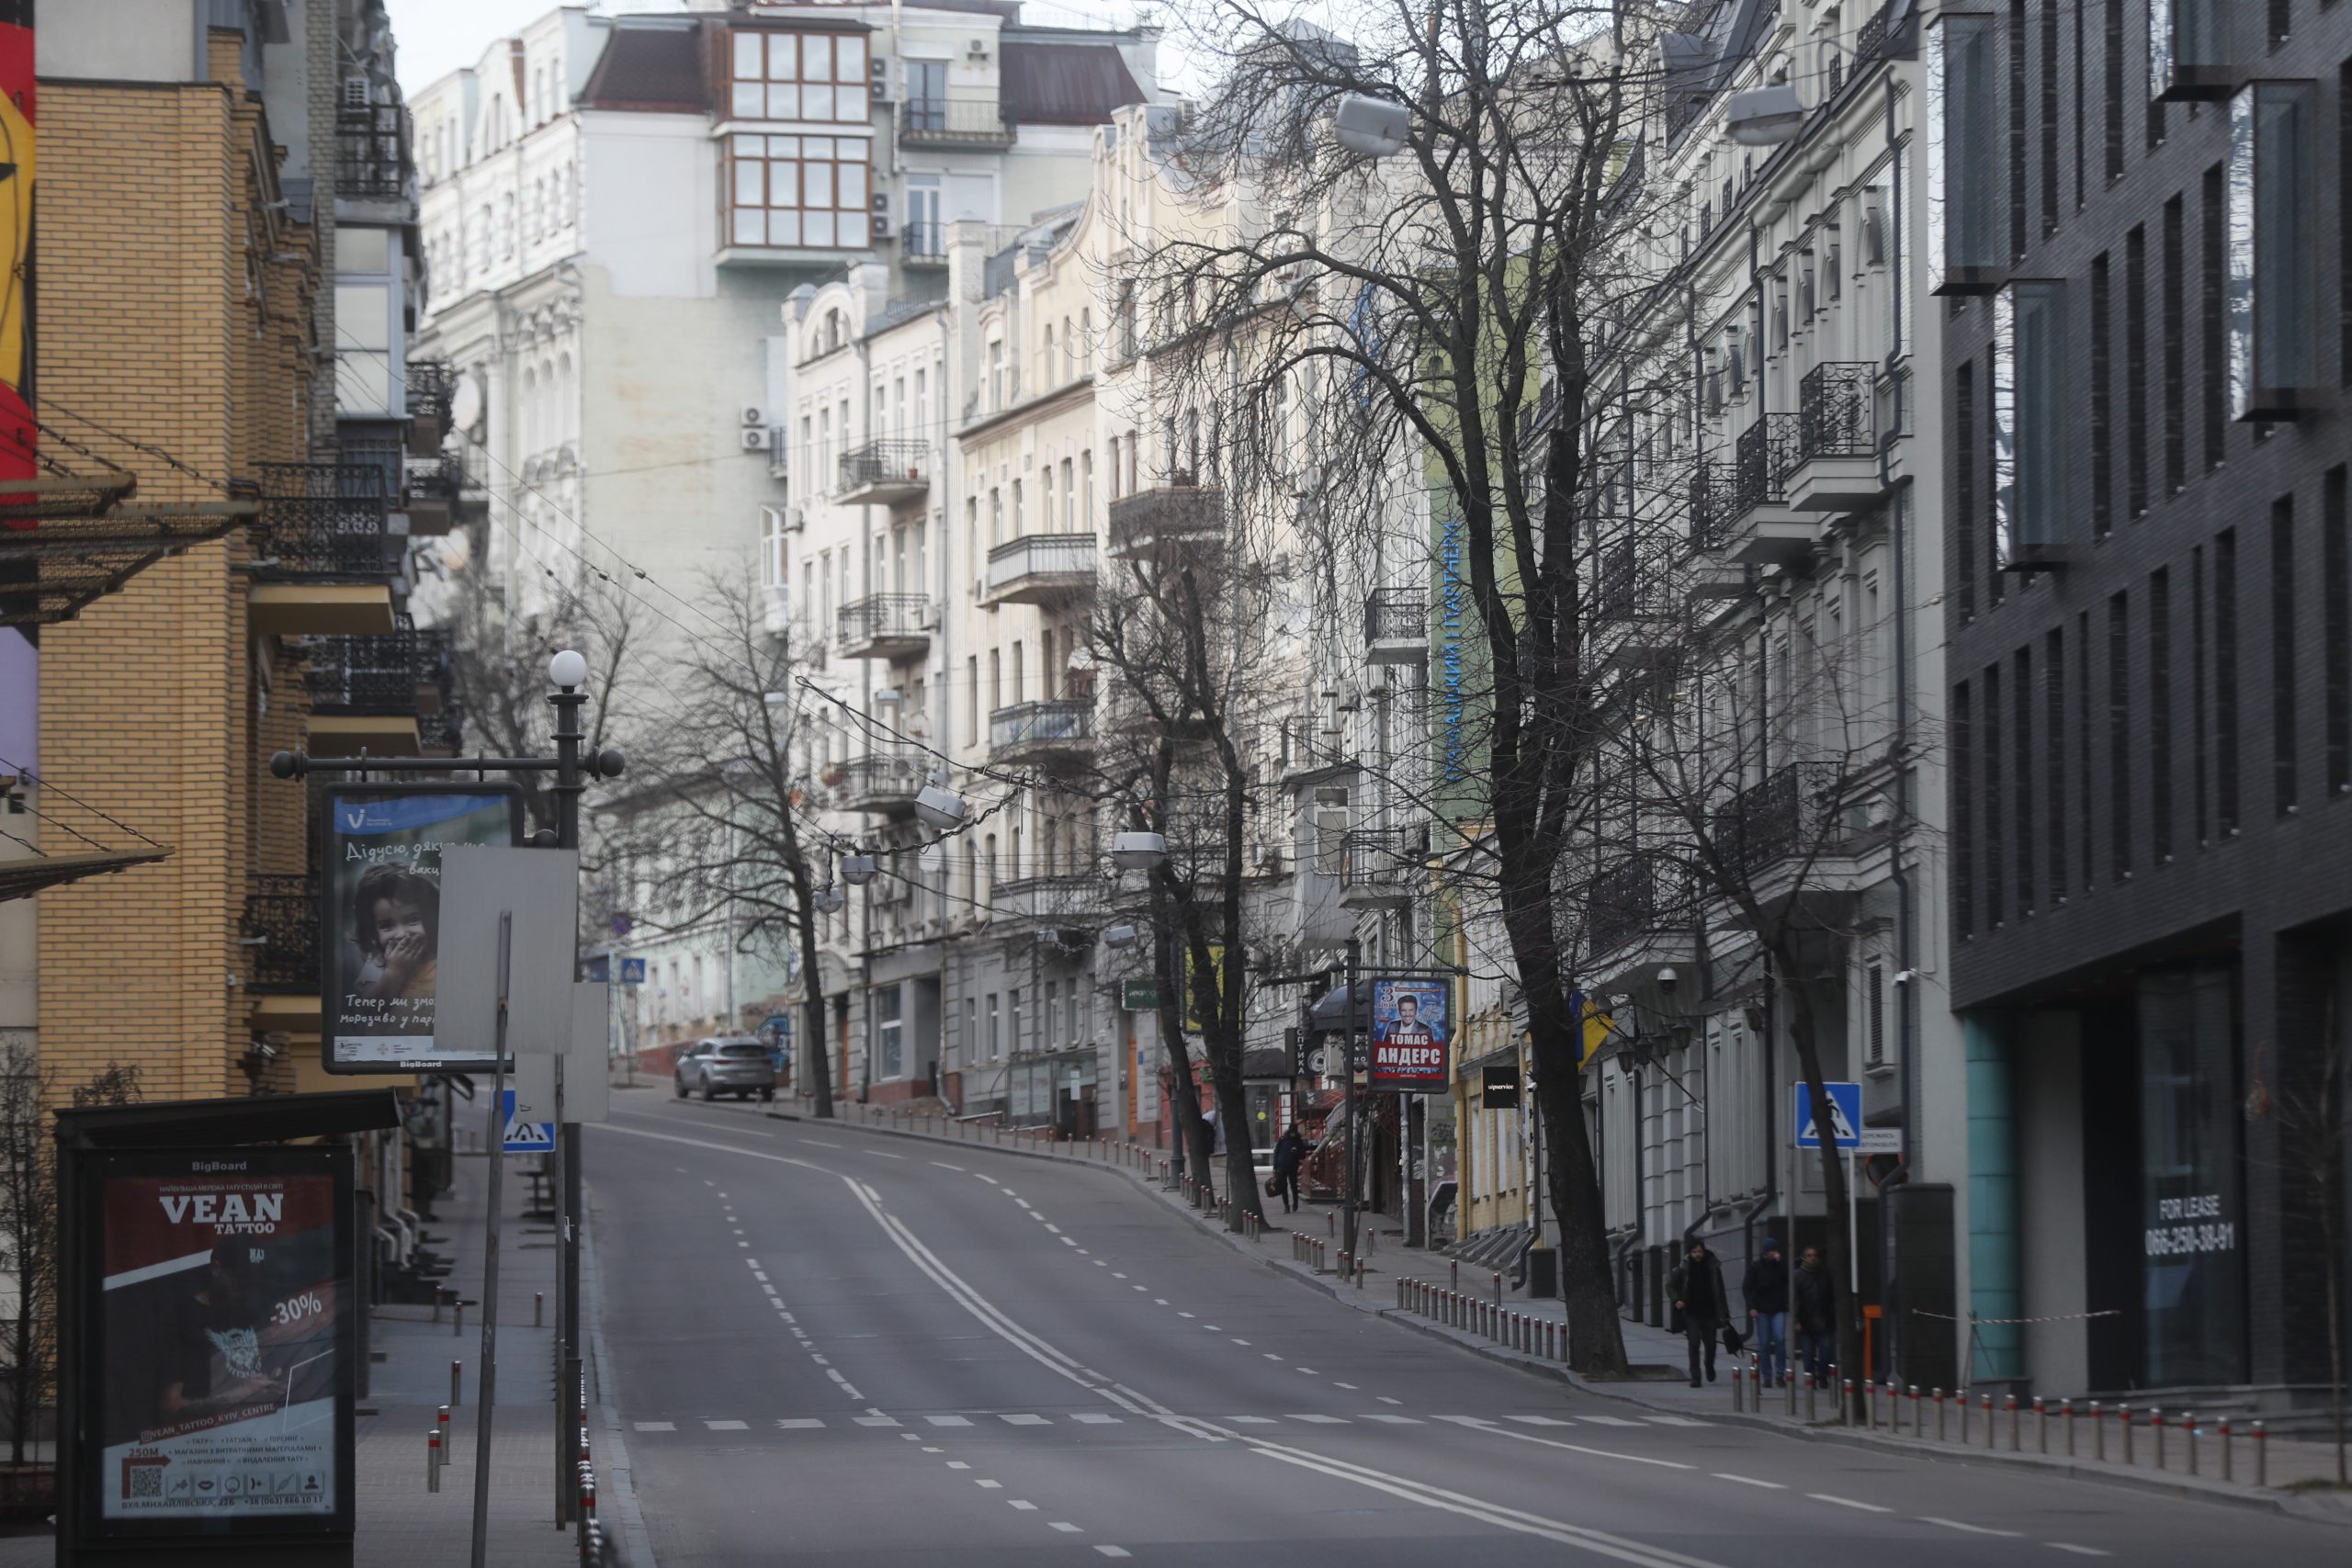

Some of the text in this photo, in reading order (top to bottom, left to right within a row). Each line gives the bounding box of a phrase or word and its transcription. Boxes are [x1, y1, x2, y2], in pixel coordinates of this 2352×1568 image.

[1442, 521, 1463, 627] ПАРТНЕРИ
[345, 842, 409, 862] Дідусю,
[345, 994, 386, 1011] Тепер
[413, 998, 435, 1010] змо
[1381, 987, 1394, 1002] 3
[339, 1014, 396, 1027] морозиво
[400, 1017, 409, 1029] у
[1389, 1034, 1429, 1045] ТОМАС
[1296, 1028, 1306, 1075] ОПТИКА
[1376, 1047, 1441, 1066] АНДЕРС
[192, 1161, 247, 1172] BigBoard
[159, 1193, 283, 1224] VEAN
[2159, 1194, 2221, 1220] FOR LEASE
[214, 1223, 275, 1235] TATTOO
[270, 1291, 322, 1324] -30%
[301, 1496, 311, 1505] 10
